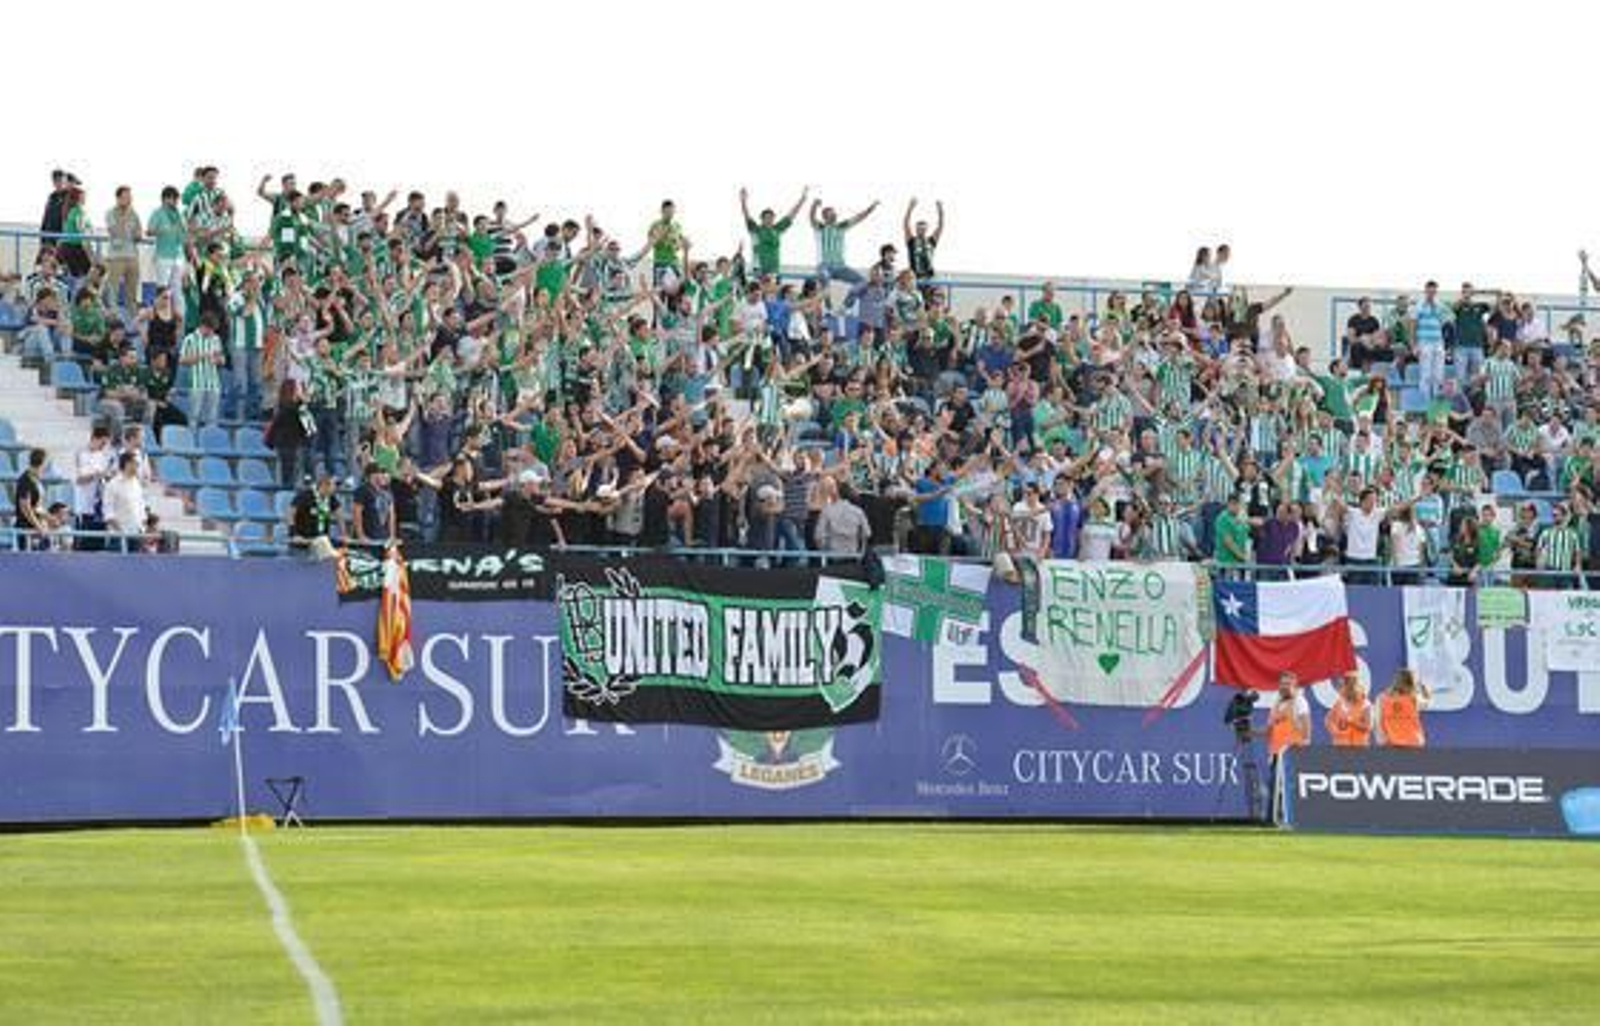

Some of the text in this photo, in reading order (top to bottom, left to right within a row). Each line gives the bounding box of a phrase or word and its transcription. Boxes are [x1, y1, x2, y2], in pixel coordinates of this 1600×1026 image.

[1049, 566, 1166, 602] ENZO
[603, 597, 844, 686] UNITED FAMILY
[1047, 604, 1178, 655] RENELLA
[417, 630, 637, 737] SU
[1013, 749, 1239, 786] CITYCAR SUR
[1298, 773, 1546, 802] POWERADE
